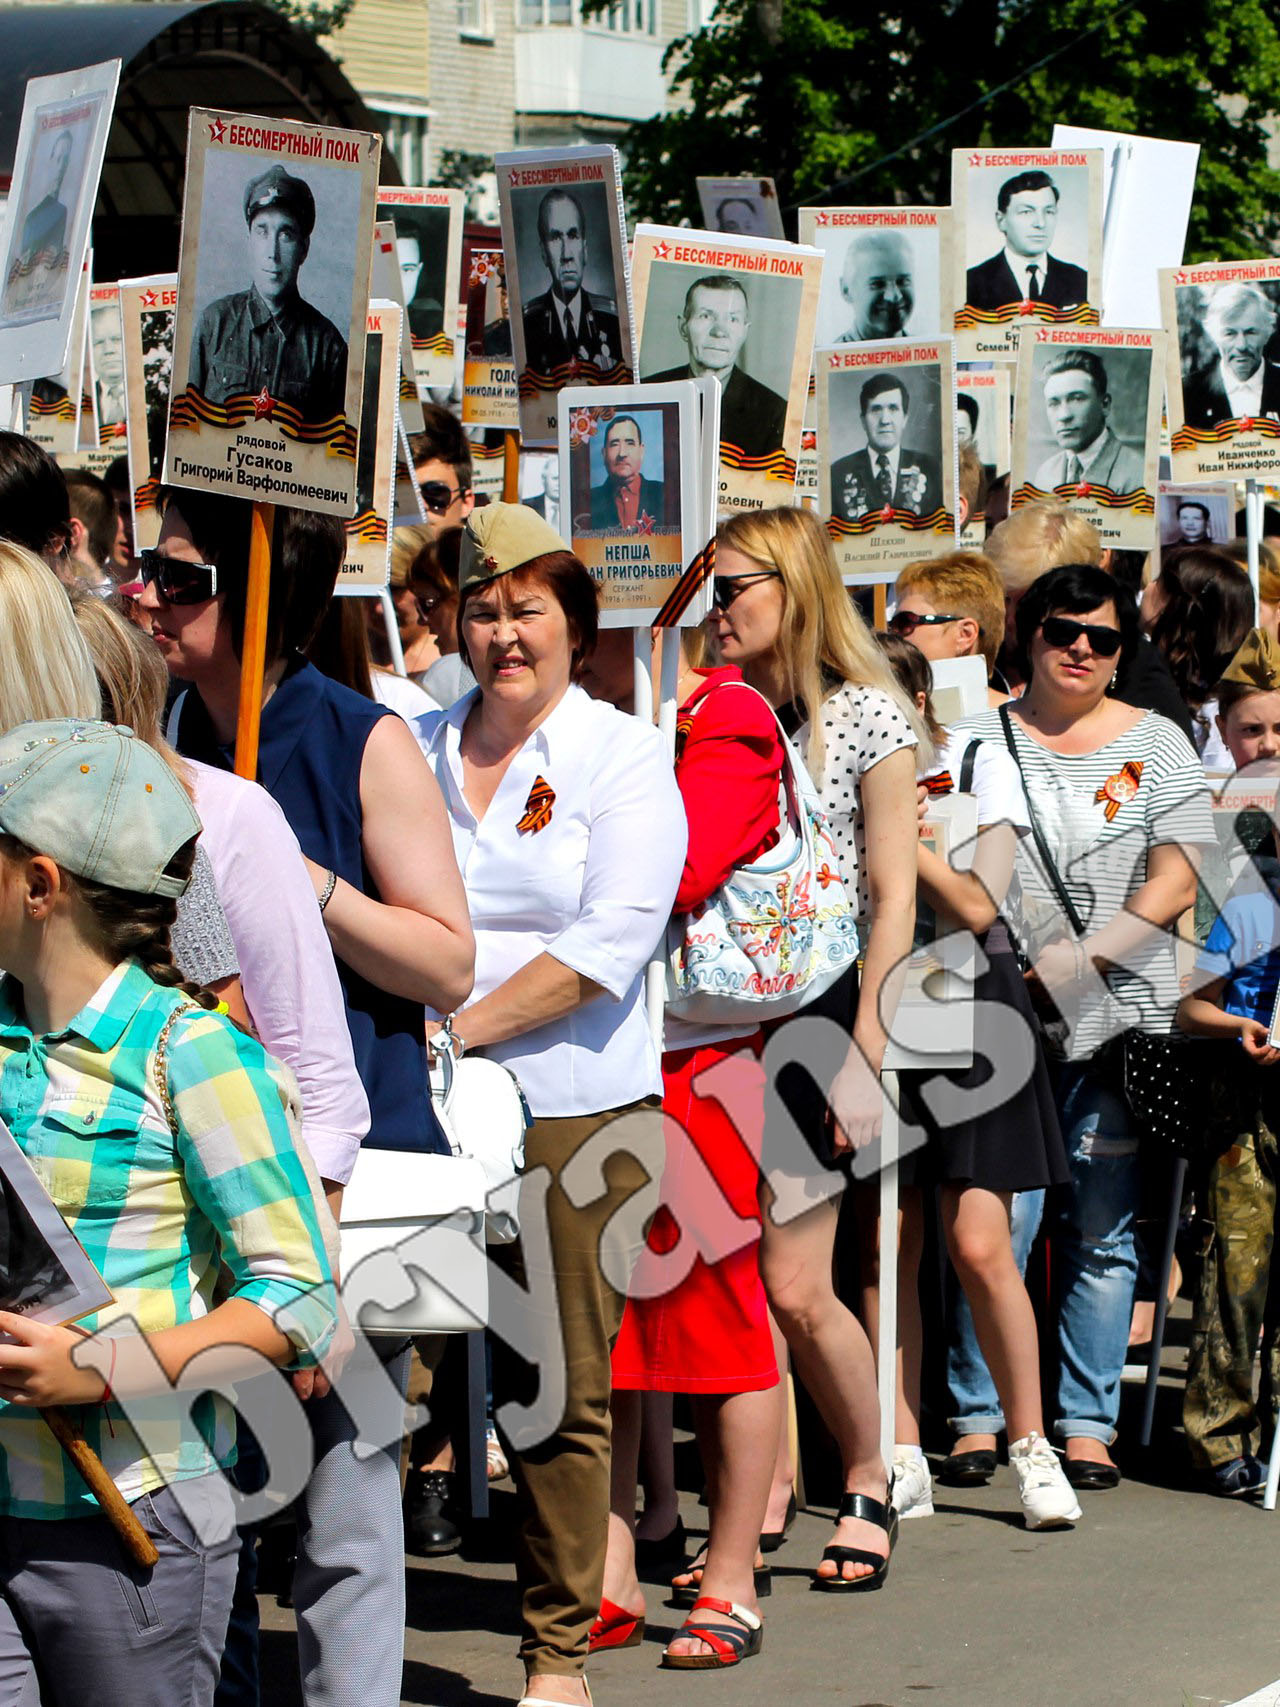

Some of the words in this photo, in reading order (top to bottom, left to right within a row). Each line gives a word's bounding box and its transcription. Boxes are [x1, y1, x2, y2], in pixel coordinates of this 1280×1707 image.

[229, 124, 323, 158] БЕССМЕРТНЫЙ
[325, 139, 360, 163] ПОЛК
[984, 152, 1058, 166] БЕССМЕРТНЫЙ
[1061, 154, 1088, 165] ПОЛК
[521, 163, 580, 185] БЕССМЕРТНЫЙ
[581, 165, 604, 181] ПОЛК
[426, 193, 449, 205] ПОЛК
[831, 210, 907, 225] БЕССМЕРТНЫЙ
[910, 213, 937, 225] ПОЛК
[674, 246, 767, 272] БЕССМЕРТНЫЙ
[770, 259, 804, 276] ПОЛК
[1190, 264, 1266, 283] БЕССМЕРТНЫЙ
[1052, 330, 1124, 345] БЕССМЕРТНЫЙ
[1126, 334, 1152, 346] ПОЛК
[976, 342, 1010, 352] Семен
[844, 346, 912, 367] БЕССМЕРТНЫЙ
[914, 347, 939, 360] ПОЛК
[464, 384, 503, 398] НИКОЛАЙ
[236, 434, 287, 452] рядовой
[226, 446, 294, 474] Гусаков
[1217, 448, 1276, 460] Иванченко
[1197, 463, 1225, 473] Иван
[173, 456, 234, 483] Григорий
[236, 468, 349, 504] Варфоломеевич
[718, 495, 764, 510] влевич
[605, 544, 652, 561] НЕПША
[607, 563, 682, 580] ГРИГОРЬЕВИЧ
[613, 584, 645, 593] СЕРЖАНТ
